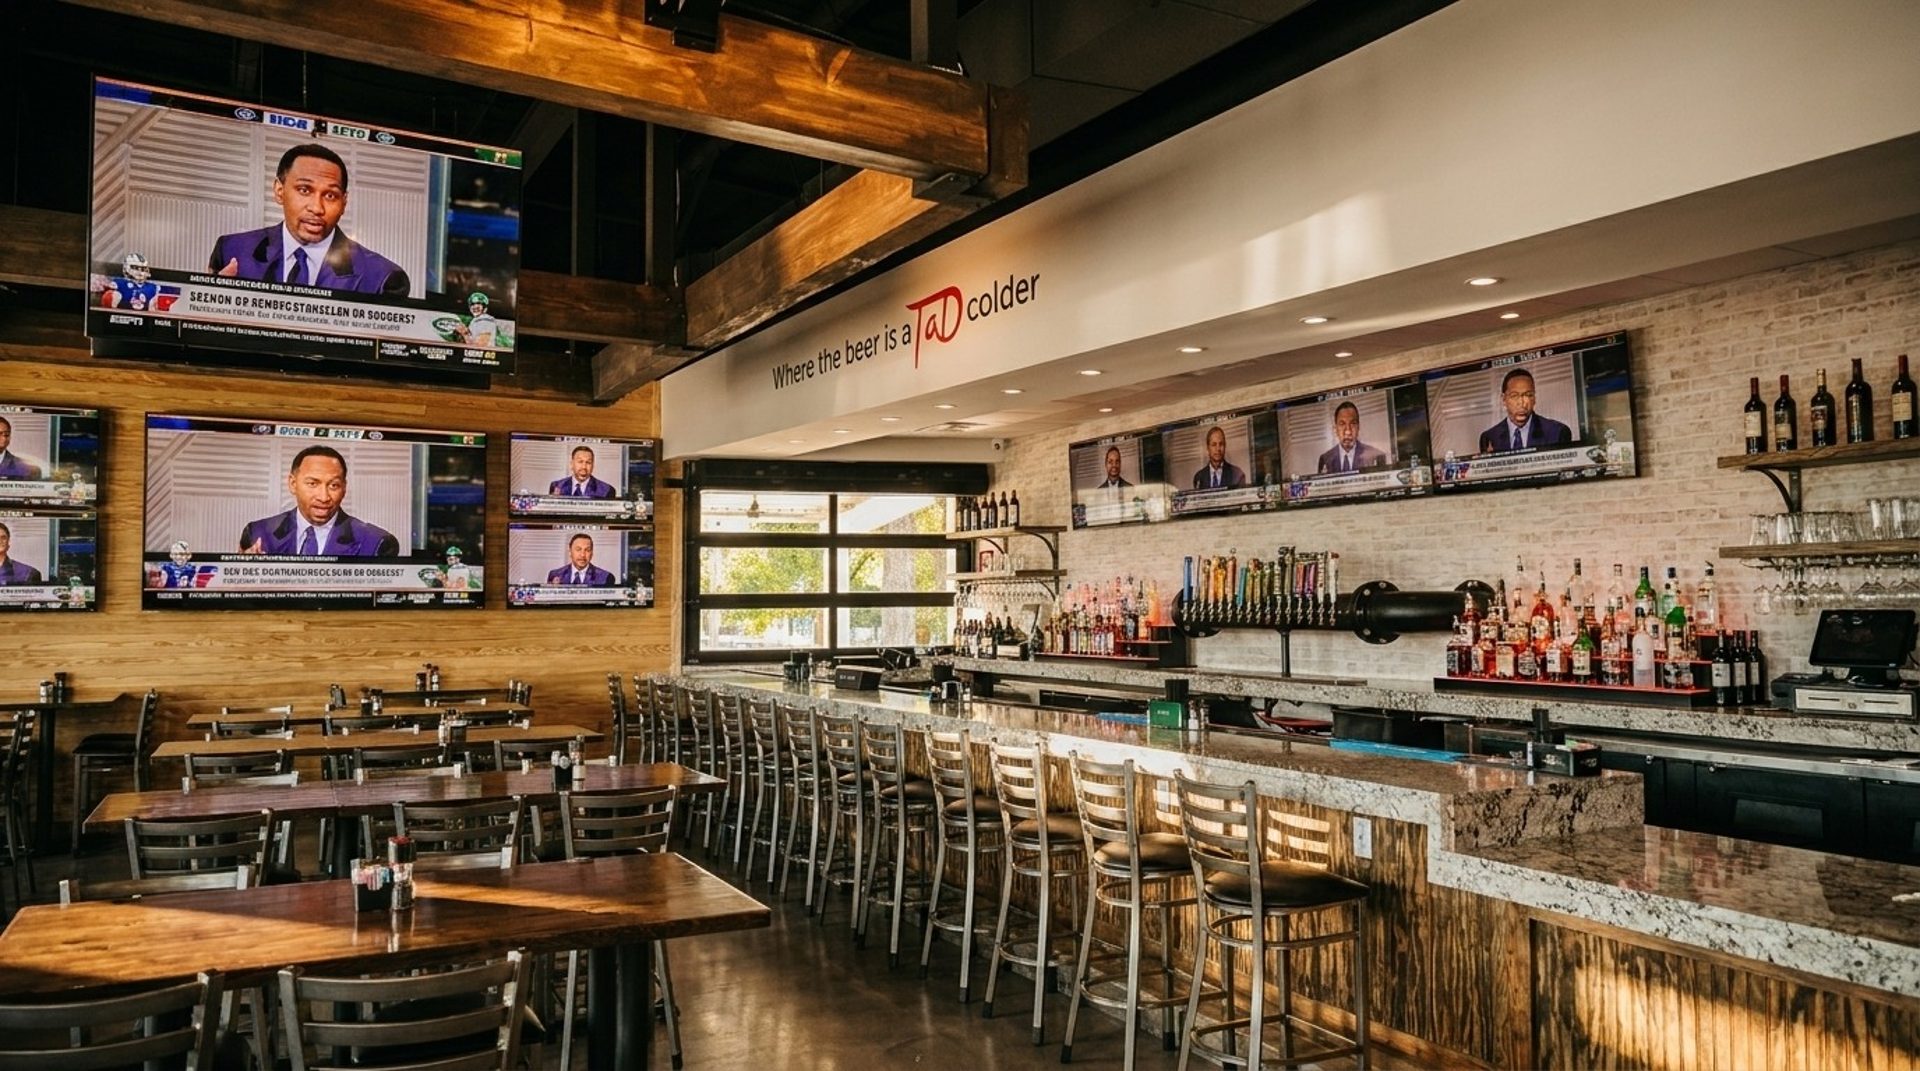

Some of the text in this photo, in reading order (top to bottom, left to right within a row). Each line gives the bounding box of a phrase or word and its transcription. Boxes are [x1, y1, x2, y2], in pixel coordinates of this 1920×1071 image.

[772, 360, 815, 390] Where
[818, 348, 841, 375] the
[845, 333, 880, 365] beer
[884, 323, 898, 352] is
[902, 322, 912, 345] a
[966, 273, 1041, 322] colder
